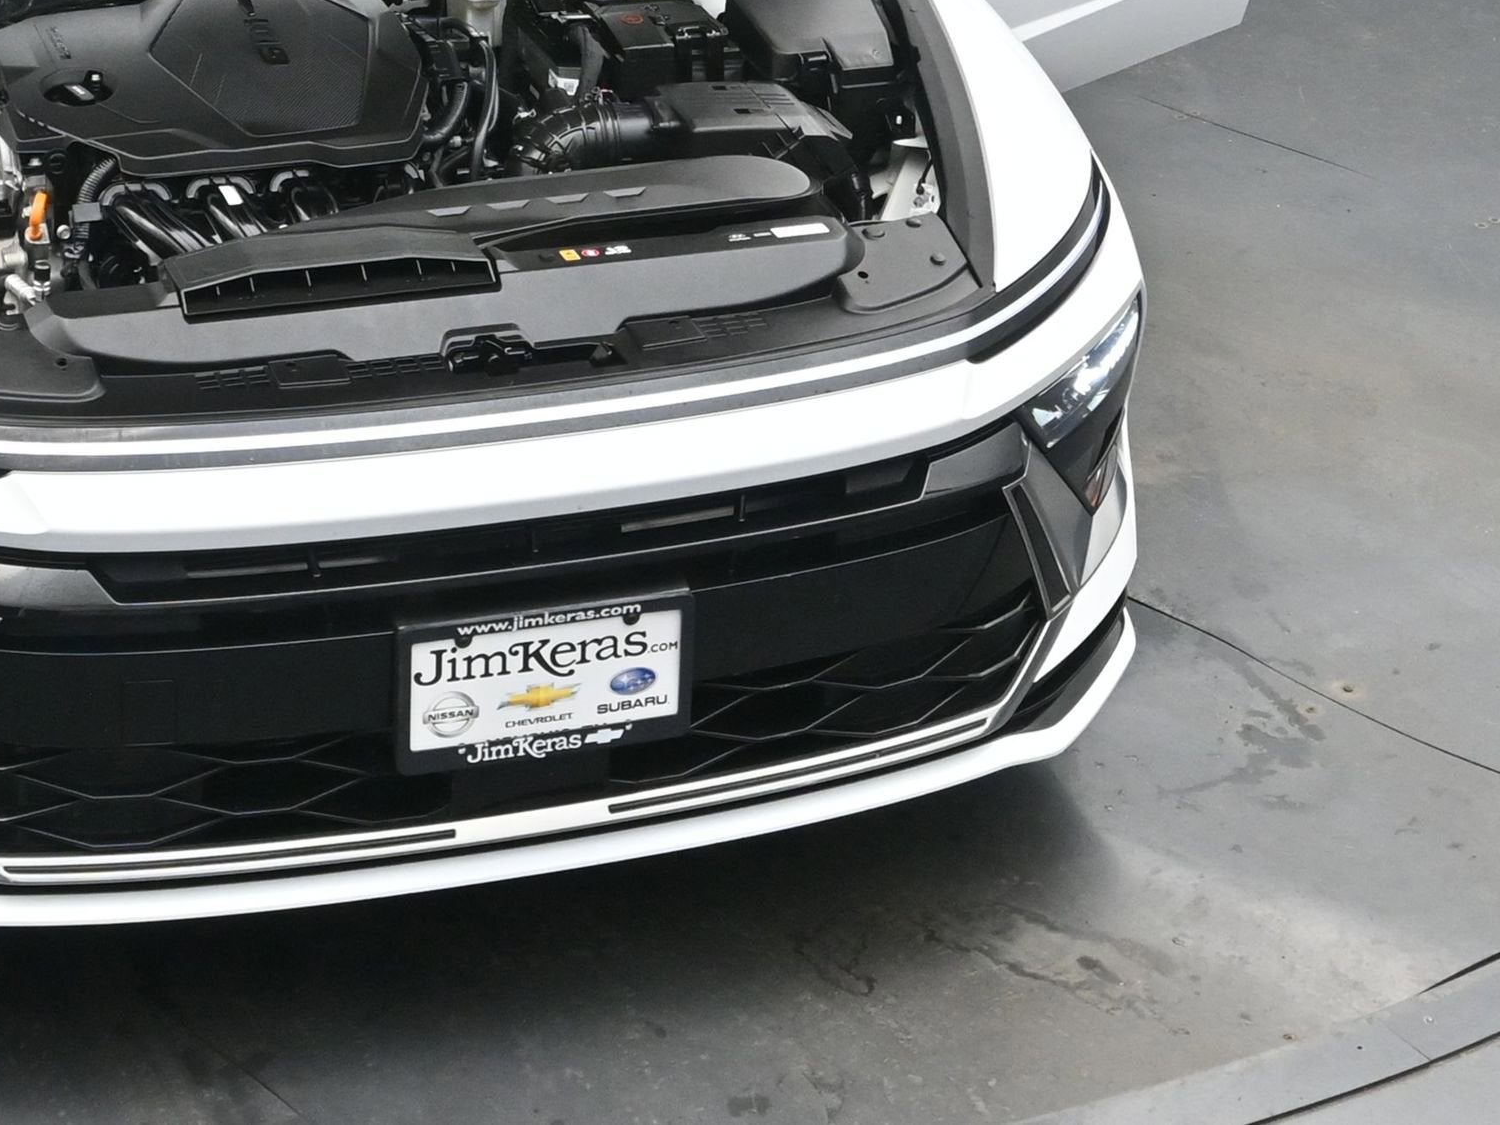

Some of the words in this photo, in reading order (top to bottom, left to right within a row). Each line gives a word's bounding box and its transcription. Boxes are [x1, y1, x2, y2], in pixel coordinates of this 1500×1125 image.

[457, 603, 642, 636] www.jimkeras.com
[596, 694, 669, 715] SUBARU
[427, 707, 475, 723] NISSAN
[504, 712, 575, 729] CHEVROLET
